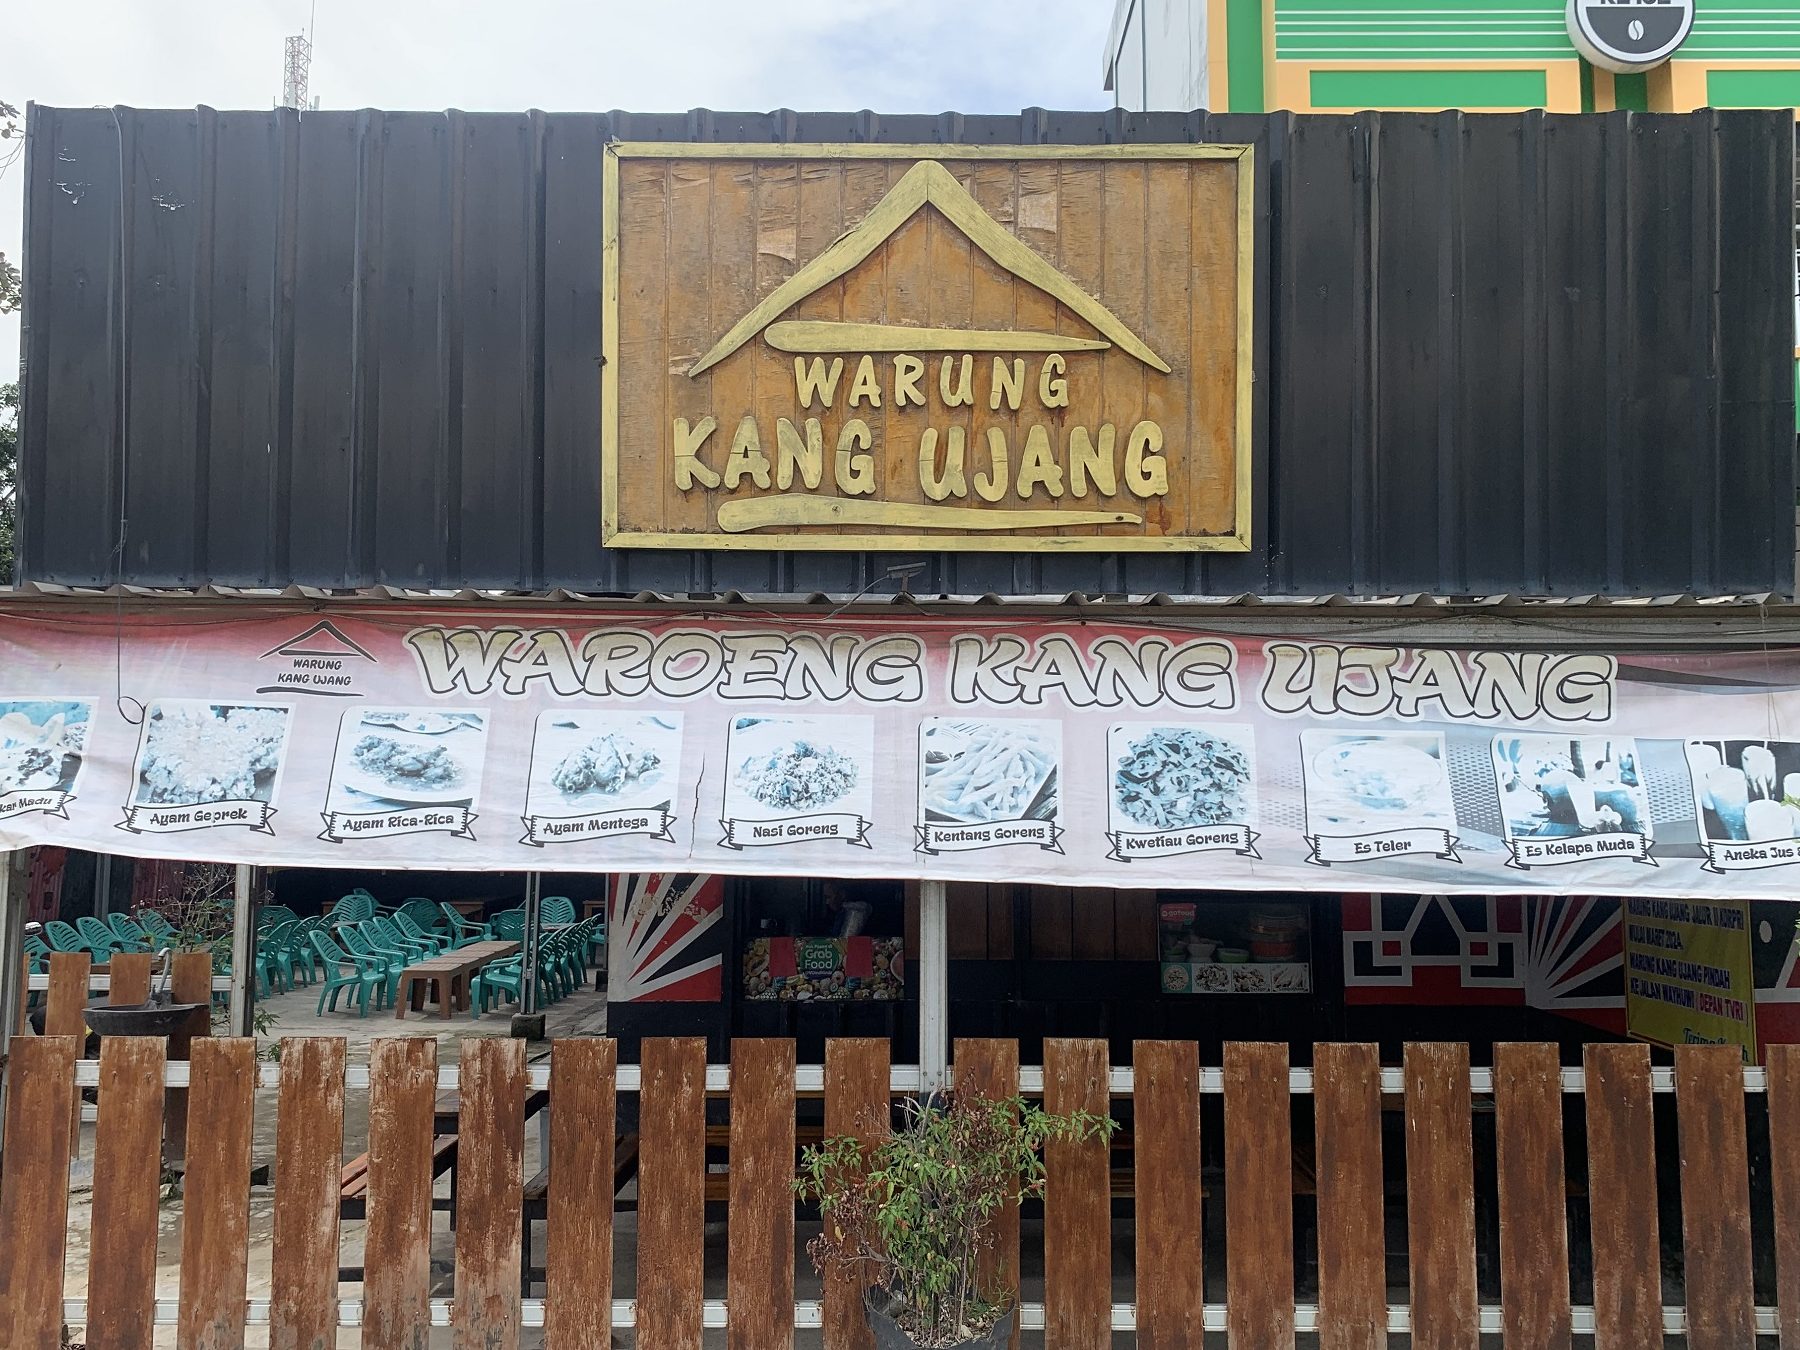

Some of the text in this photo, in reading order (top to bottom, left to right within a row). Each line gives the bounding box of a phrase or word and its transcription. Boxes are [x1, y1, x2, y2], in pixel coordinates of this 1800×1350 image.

[794, 354, 1069, 410] WARUNG
[673, 416, 1168, 501] KANG UJANG
[293, 659, 342, 670] WARUNG
[277, 673, 351, 686] KANG UJANG
[405, 627, 1617, 722] WAROENG KANG UJANG
[19, 797, 52, 808] Madu
[150, 808, 248, 826] Ayam Geprek
[343, 813, 454, 831] Ayam Rica-Rica
[543, 816, 648, 835] Ayam Mentega
[753, 822, 839, 838] Nasi Goreng
[934, 826, 1045, 843] Kentang Goreng
[1125, 831, 1239, 850] Kwetiau Goreng
[1354, 840, 1412, 854] Es Teler
[1525, 839, 1635, 857] Es Kelapa Muda
[1724, 848, 1768, 861] Aneka
[1770, 847, 1794, 858] Jus
[805, 949, 833, 959] Grab
[805, 959, 833, 969] Food
[1656, 957, 1677, 977] KANG
[1678, 960, 1702, 983] UJANG
[1703, 966, 1730, 989] PINDAH
